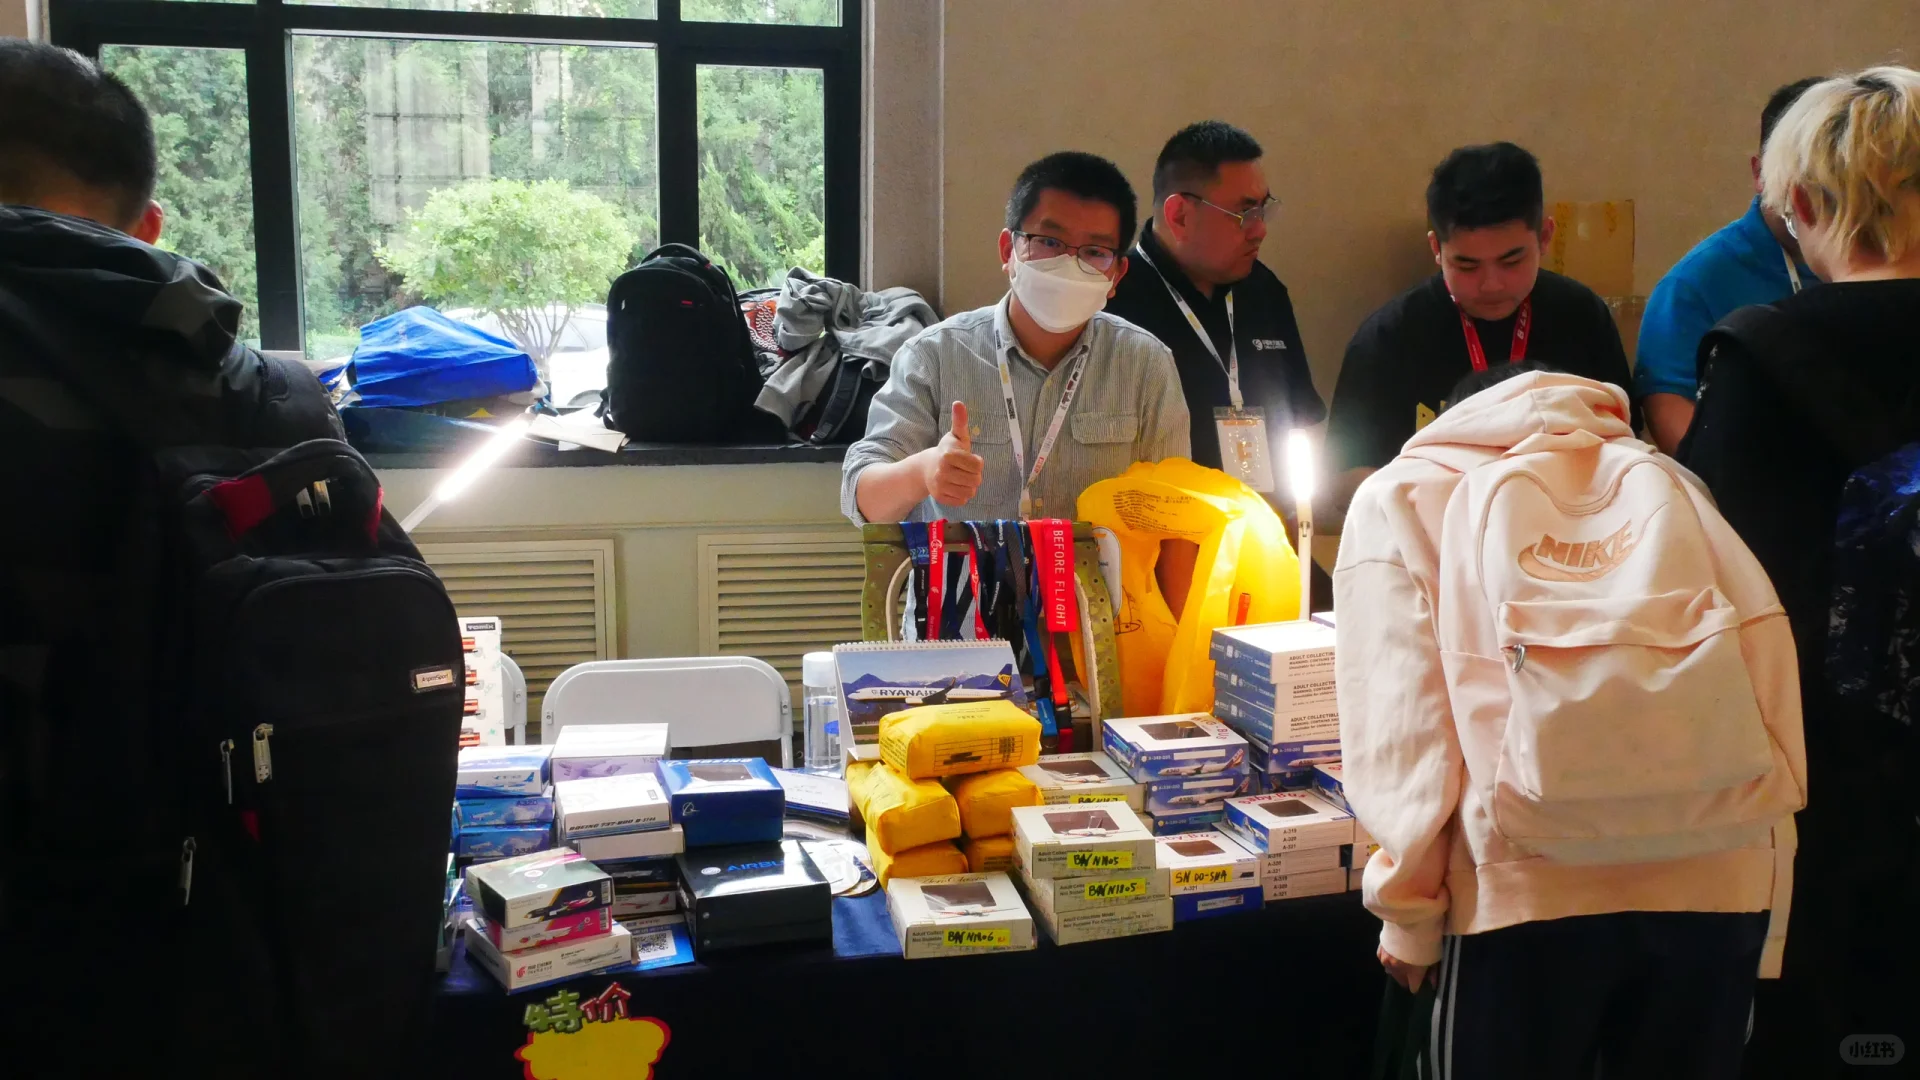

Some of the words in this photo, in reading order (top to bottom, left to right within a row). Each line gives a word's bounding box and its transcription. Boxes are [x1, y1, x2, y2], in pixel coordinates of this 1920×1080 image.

[1052, 530, 1065, 574] BEFORE
[1536, 520, 1633, 568] NIKE
[1054, 580, 1067, 627] FLIGHT
[879, 689, 937, 697] RYANAIR
[523, 981, 632, 1034] 特价
